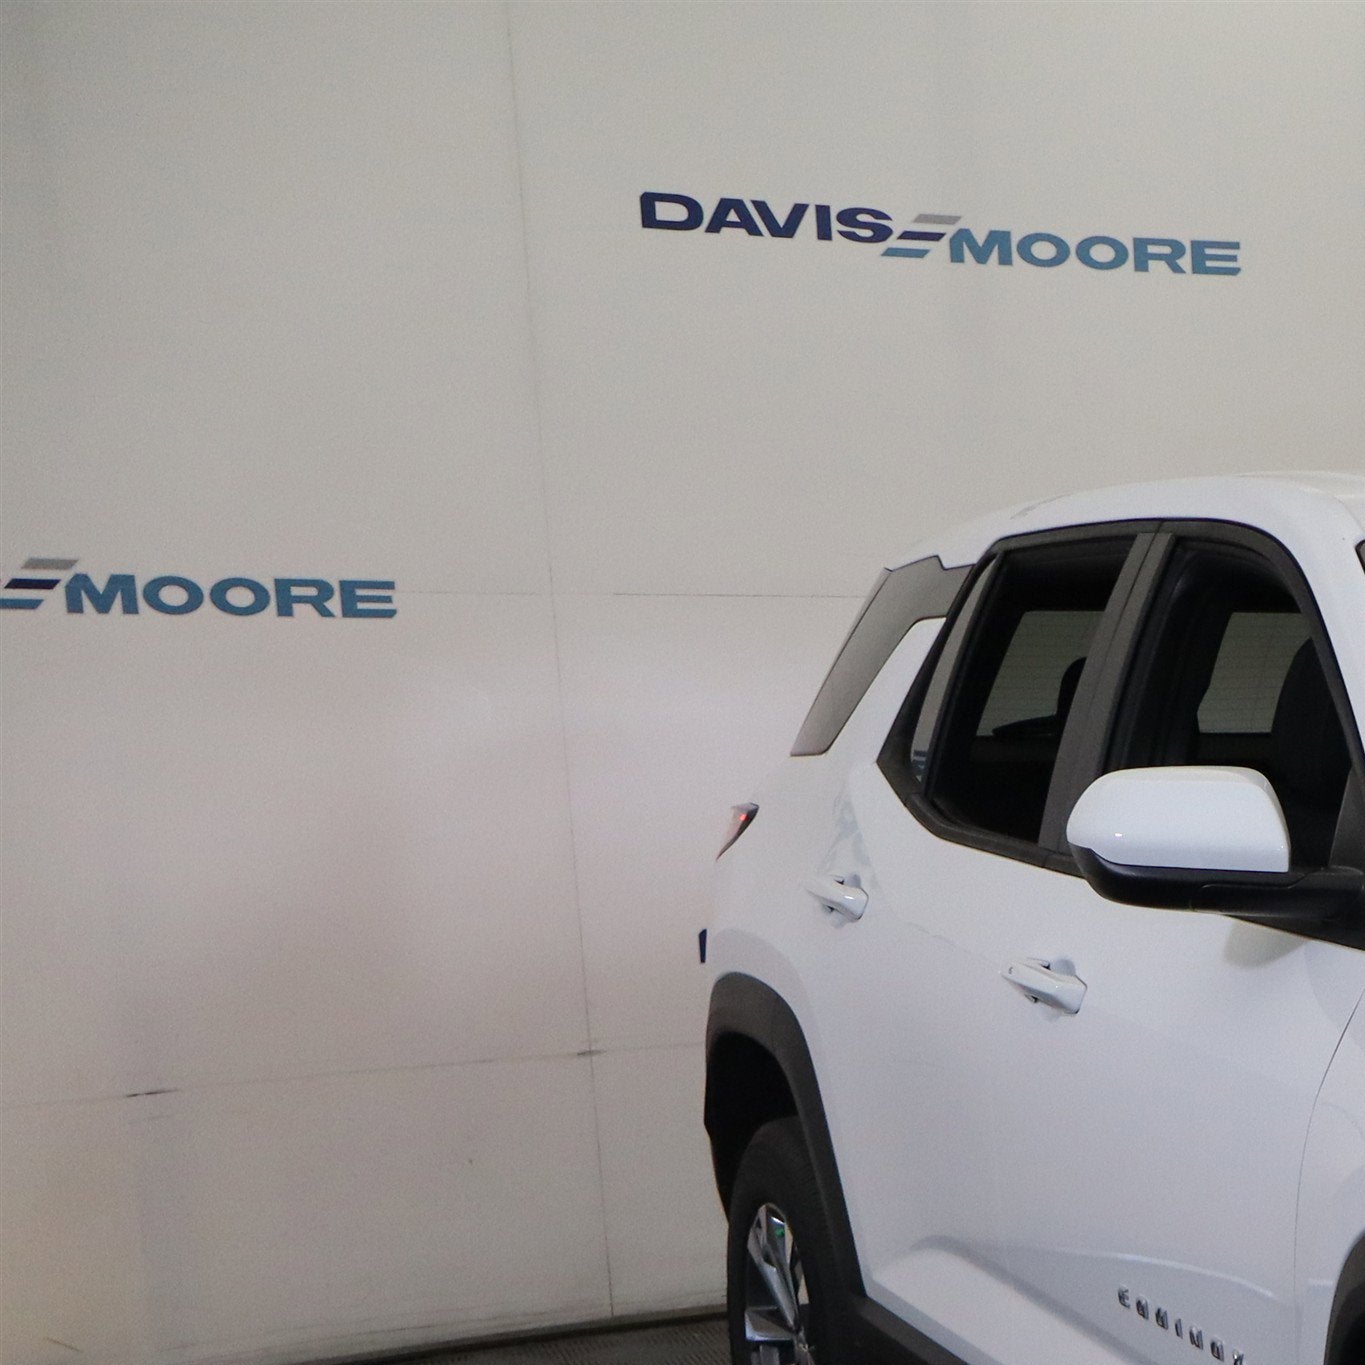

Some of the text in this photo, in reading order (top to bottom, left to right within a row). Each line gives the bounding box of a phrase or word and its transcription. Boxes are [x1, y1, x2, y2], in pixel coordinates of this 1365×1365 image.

[640, 191, 1241, 277] DAVIS MOORE
[63, 572, 398, 619] MOORE
